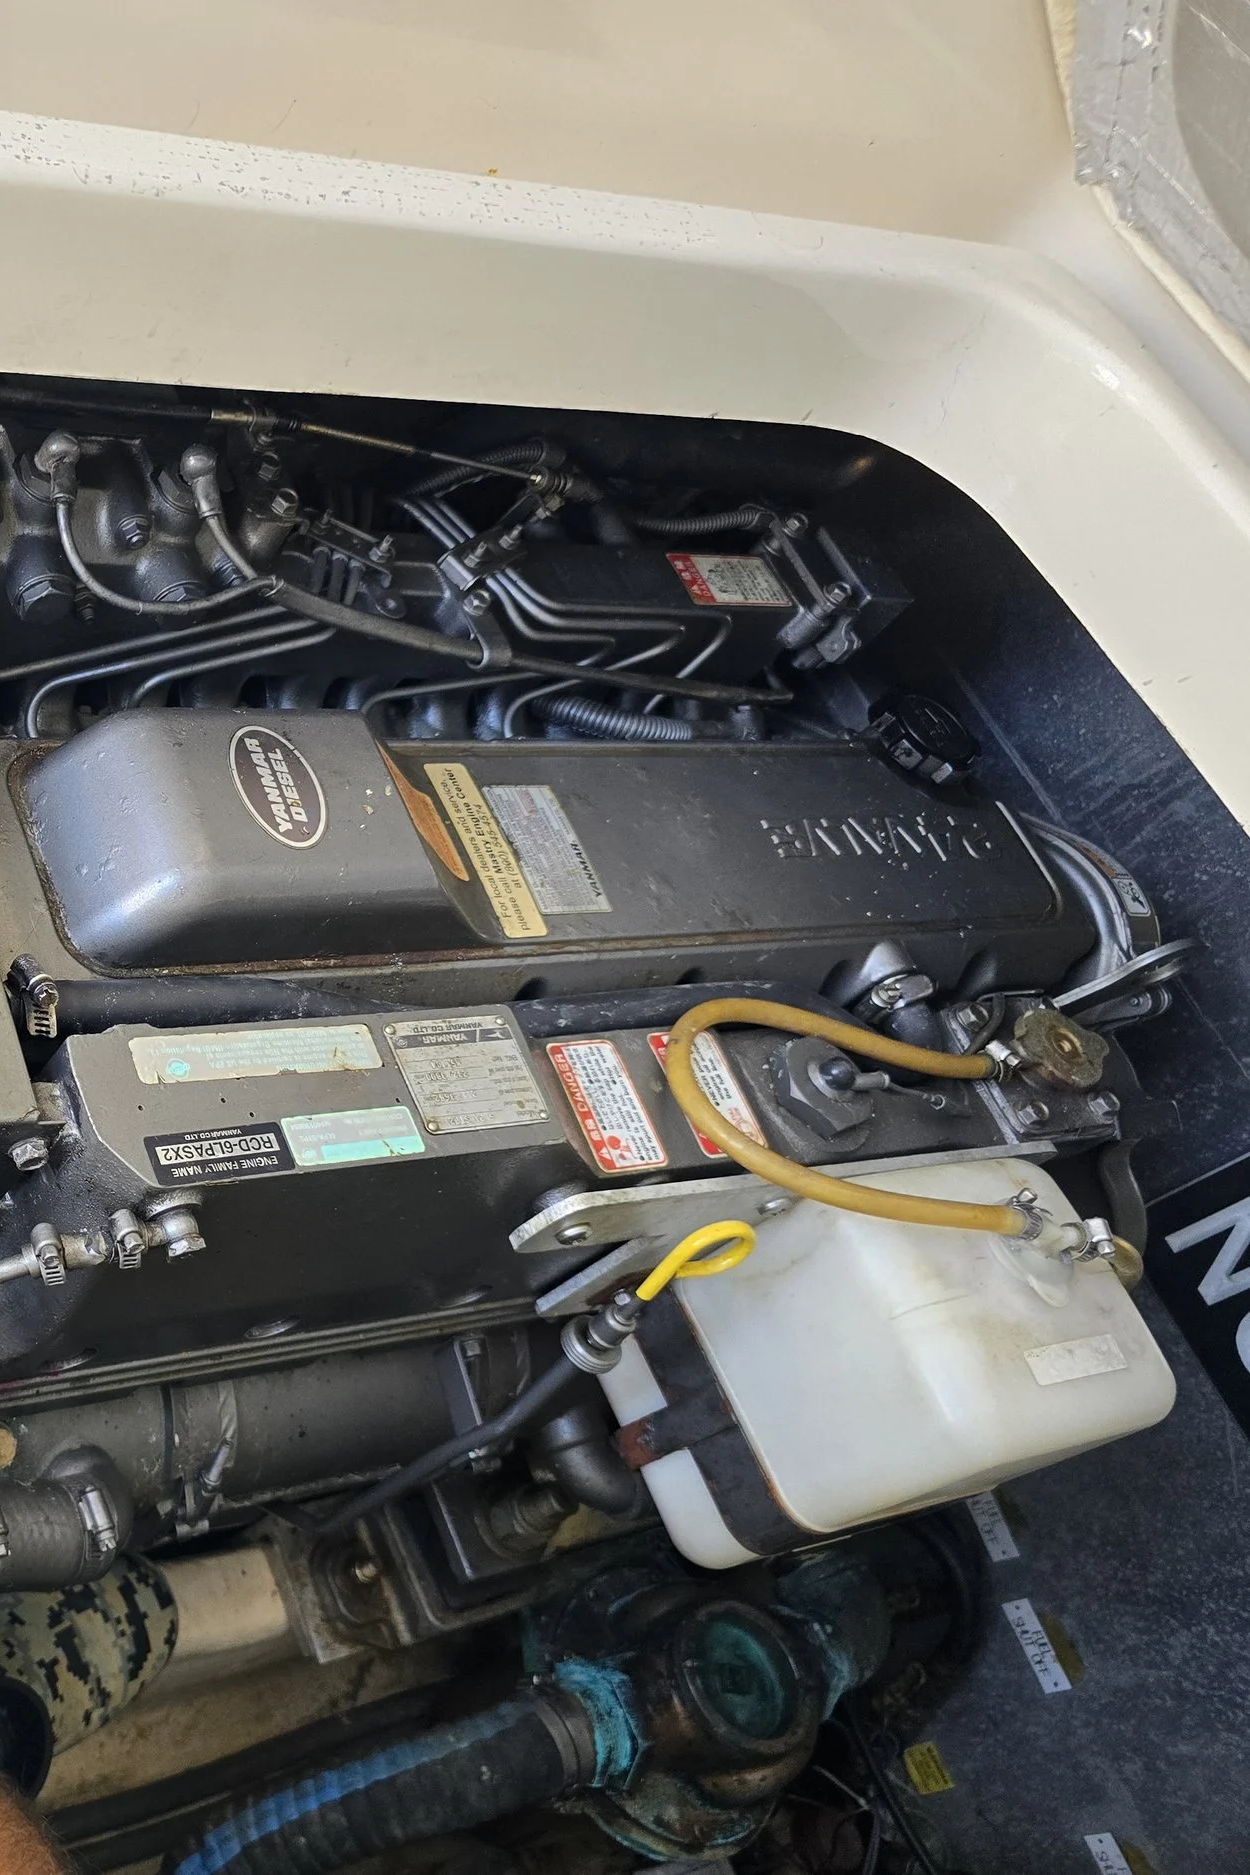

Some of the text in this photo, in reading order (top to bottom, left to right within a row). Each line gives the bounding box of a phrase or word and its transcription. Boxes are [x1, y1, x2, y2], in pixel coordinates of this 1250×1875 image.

[243, 738, 293, 833] YANMAR
[267, 747, 308, 821] DIESEL
[438, 778, 511, 918] For local dealers and service,
[443, 767, 530, 930] please call Mastry Engine Center
[473, 803, 522, 888] at (800) 545-4574
[570, 842, 602, 897] YANMAR
[422, 1034, 466, 1042] YANMAR
[553, 1052, 587, 1112] DANGER
[701, 1074, 717, 1100] NEVER
[160, 1133, 274, 1160] RCD-6LPASX2
[210, 1128, 241, 1137] YANMAR
[171, 1156, 278, 1178] ENGINE FAMILY NAME
[1011, 1616, 1049, 1676] SHUT OFF
[1030, 1629, 1051, 1658] FUEL
